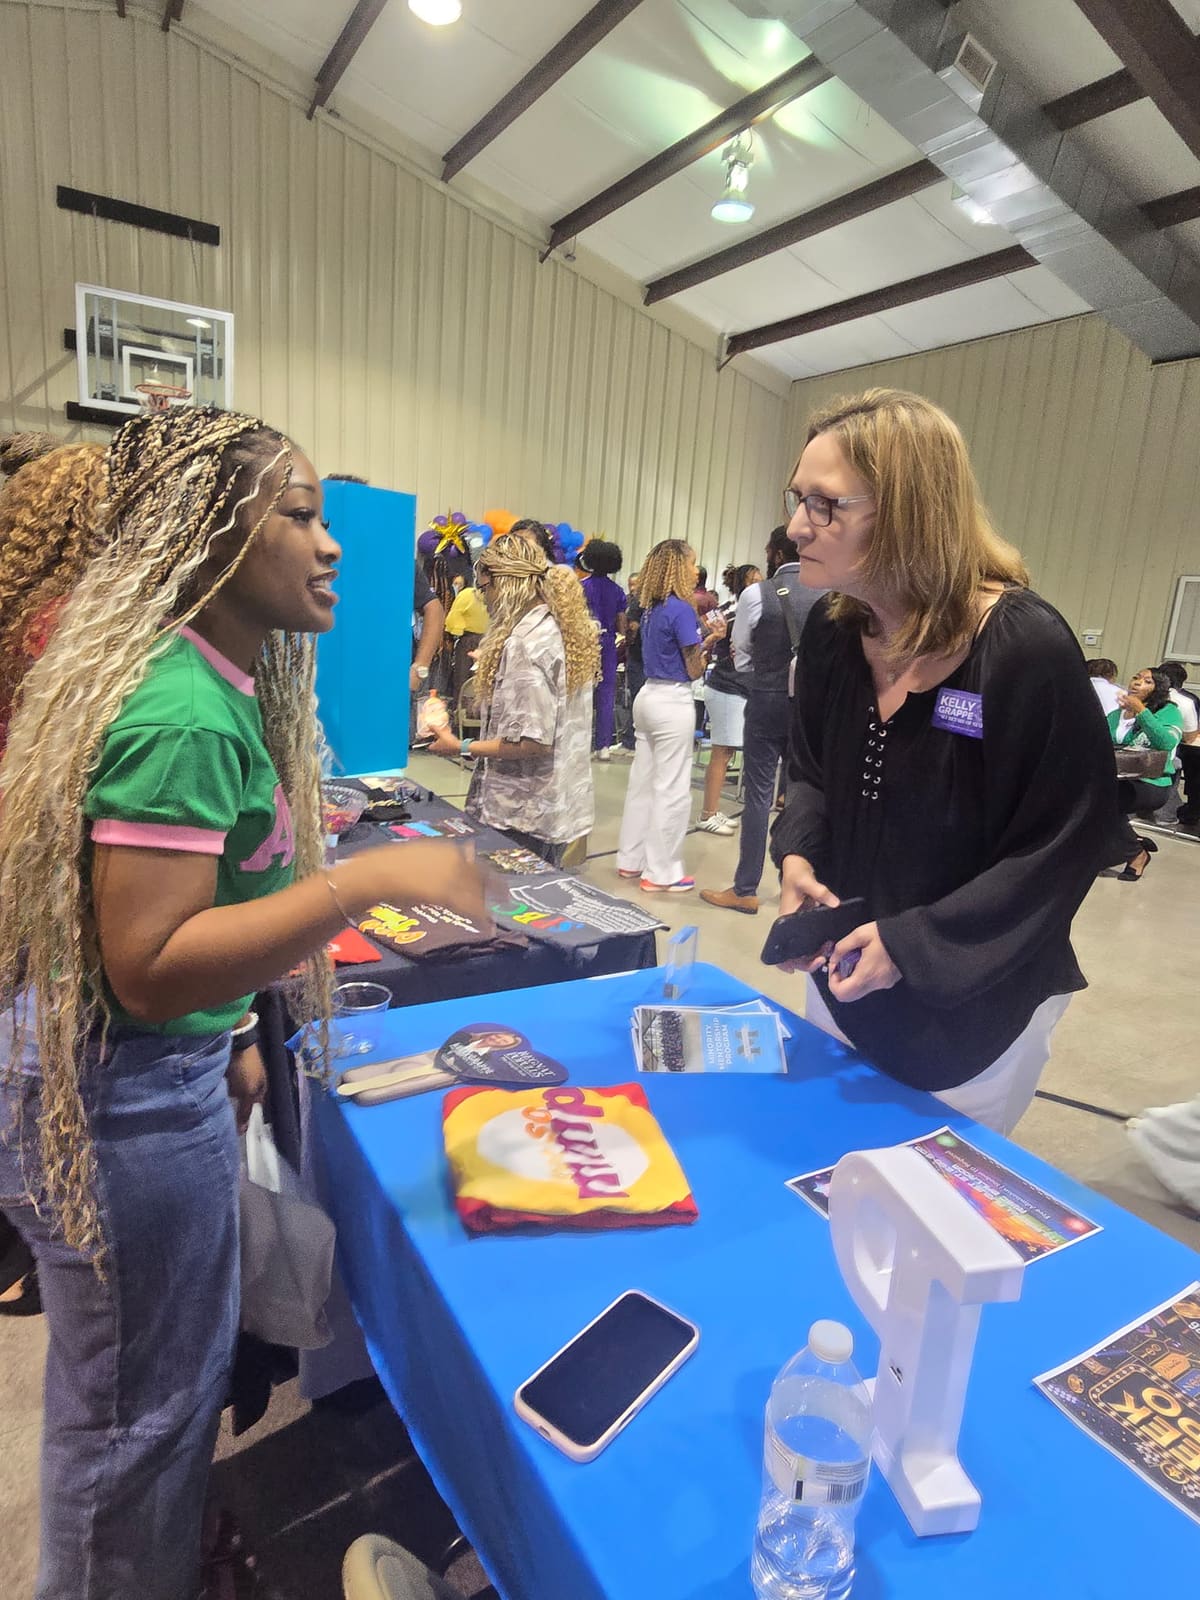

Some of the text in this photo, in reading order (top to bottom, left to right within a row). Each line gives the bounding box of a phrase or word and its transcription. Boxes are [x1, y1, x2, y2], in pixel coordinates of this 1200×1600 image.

[938, 705, 973, 720] GRAPPE
[941, 695, 976, 711] KELLY
[704, 1024, 715, 1064] MINORITY
[712, 1017, 725, 1071] MENTORSHIP
[721, 1024, 732, 1064] PROGRAM
